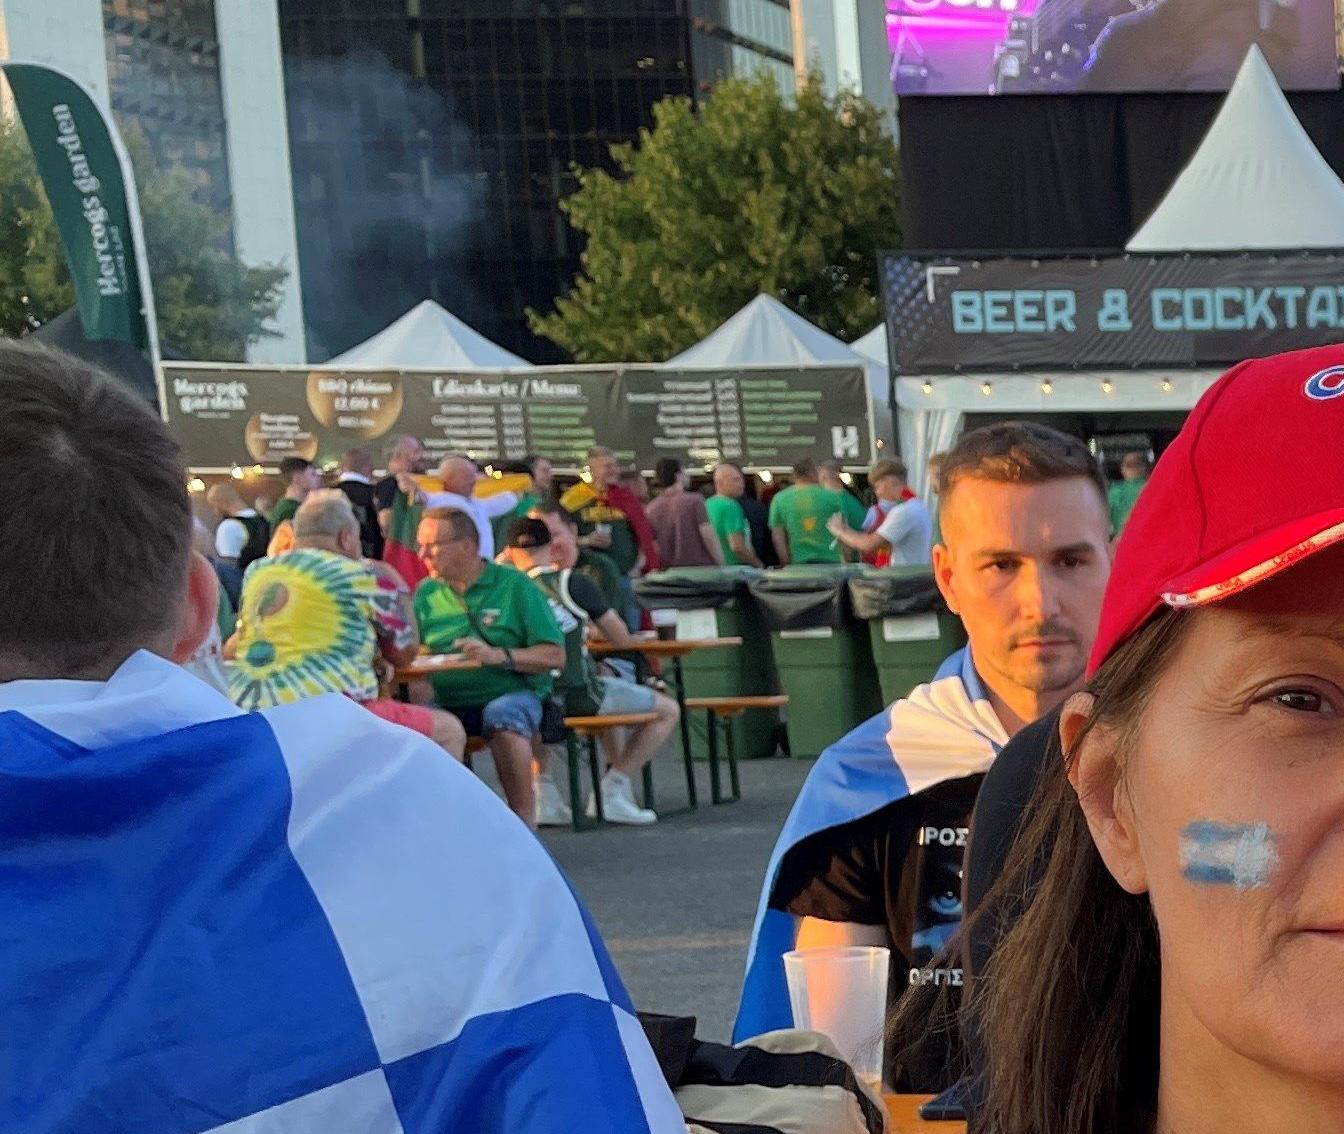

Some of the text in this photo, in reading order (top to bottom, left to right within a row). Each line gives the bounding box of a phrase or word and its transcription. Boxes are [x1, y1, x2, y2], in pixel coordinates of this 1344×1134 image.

[52, 103, 101, 194] garden
[81, 196, 122, 296] Hercogs
[951, 289, 1076, 333] BEER
[1098, 288, 1132, 332] &
